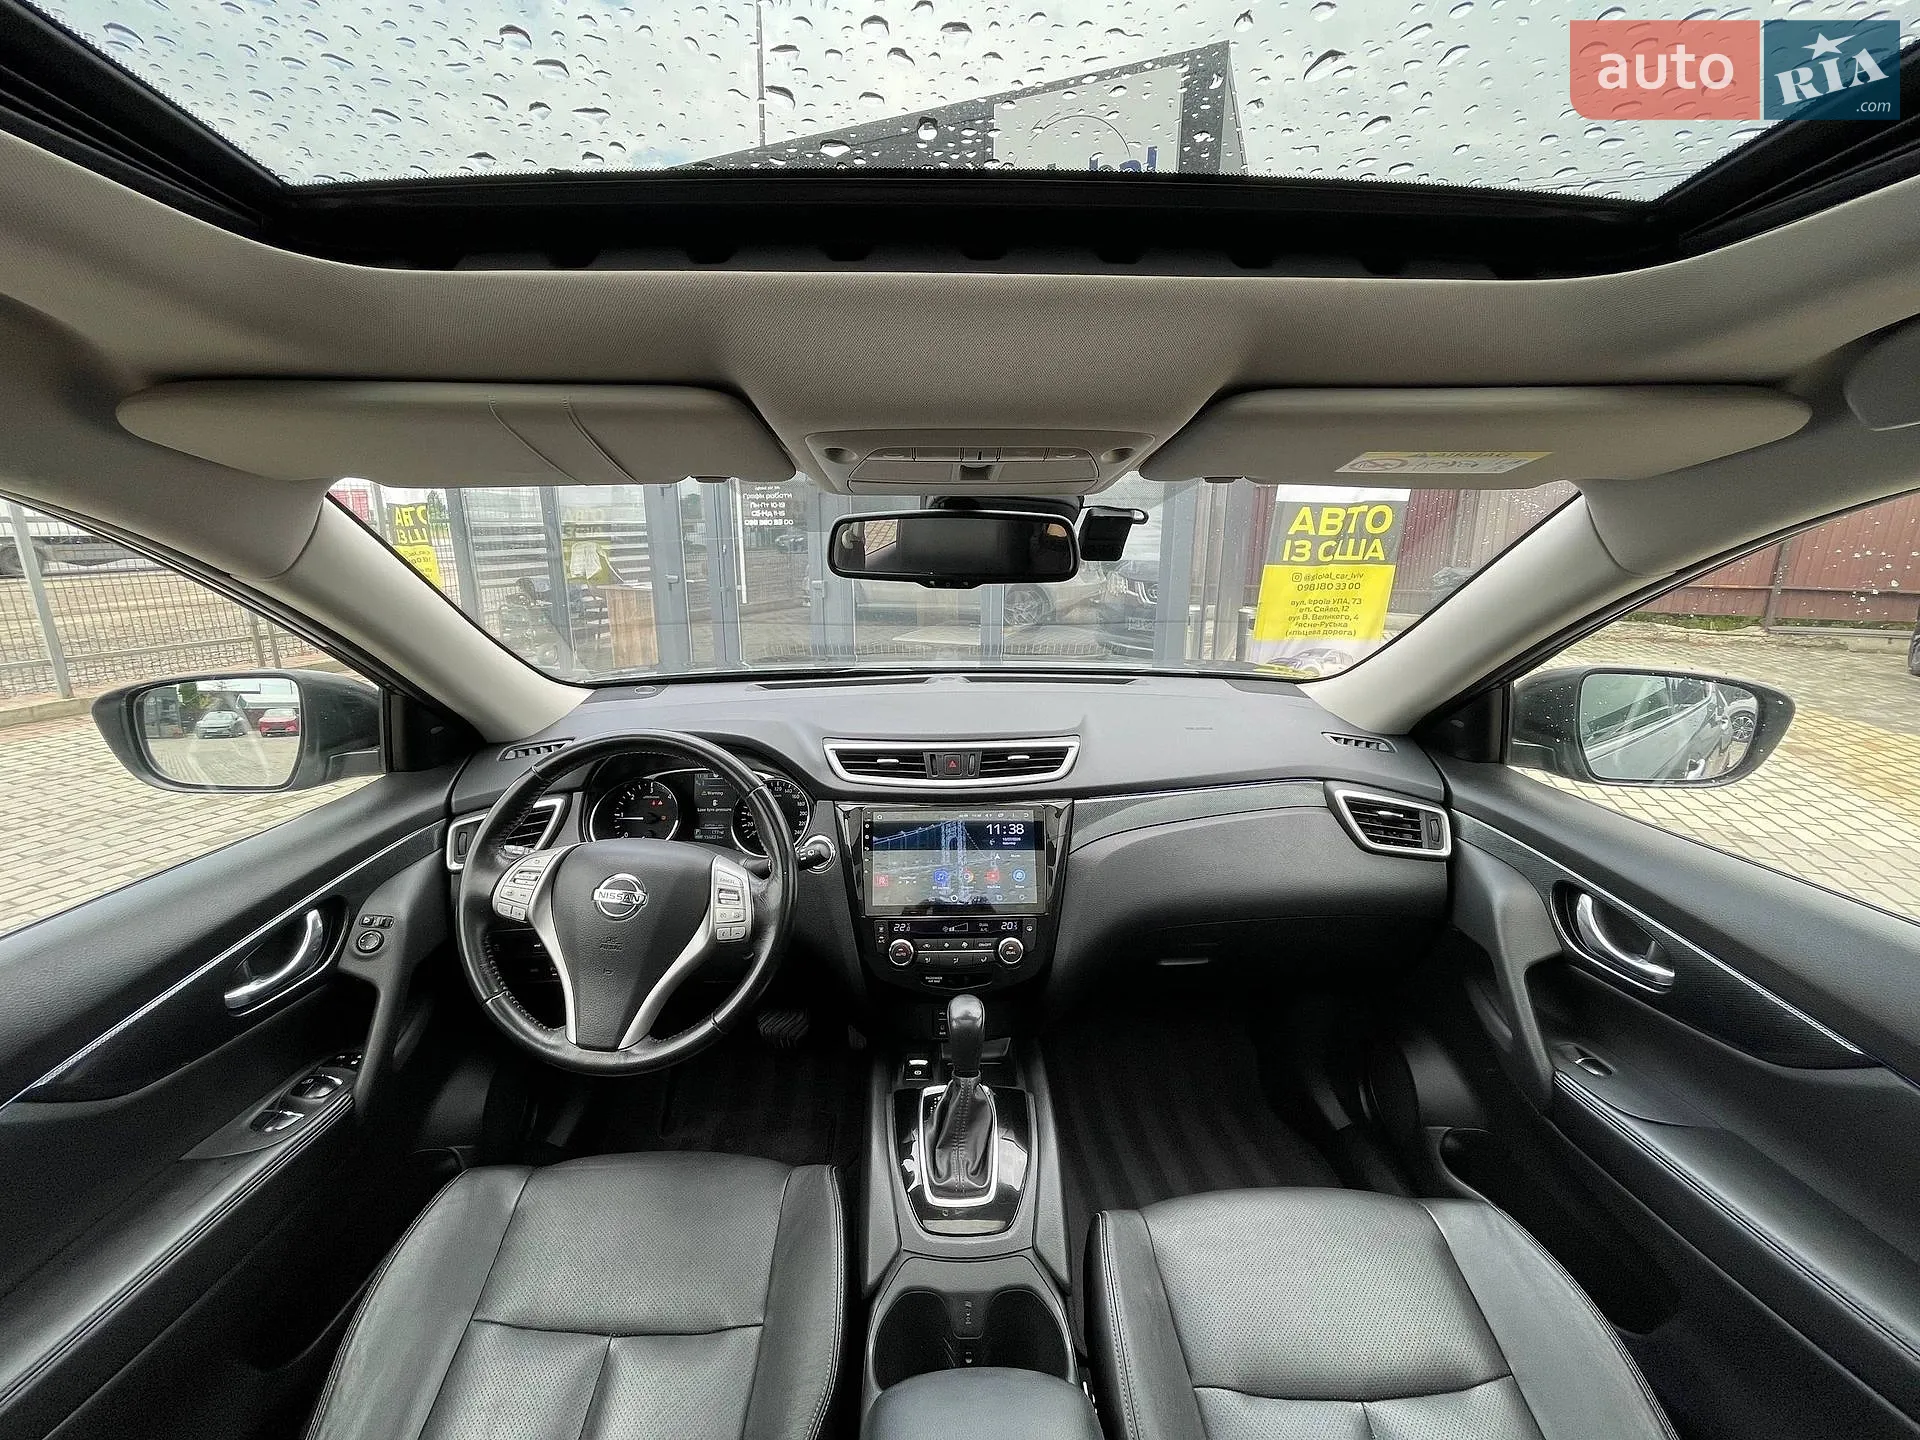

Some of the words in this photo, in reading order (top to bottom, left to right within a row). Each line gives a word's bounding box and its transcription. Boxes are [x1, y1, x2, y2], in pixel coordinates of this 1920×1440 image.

[1288, 504, 1393, 536] АВТО
[1318, 538, 1386, 562] США
[986, 823, 1025, 835] 11:38
[598, 891, 640, 902] NISSAN
